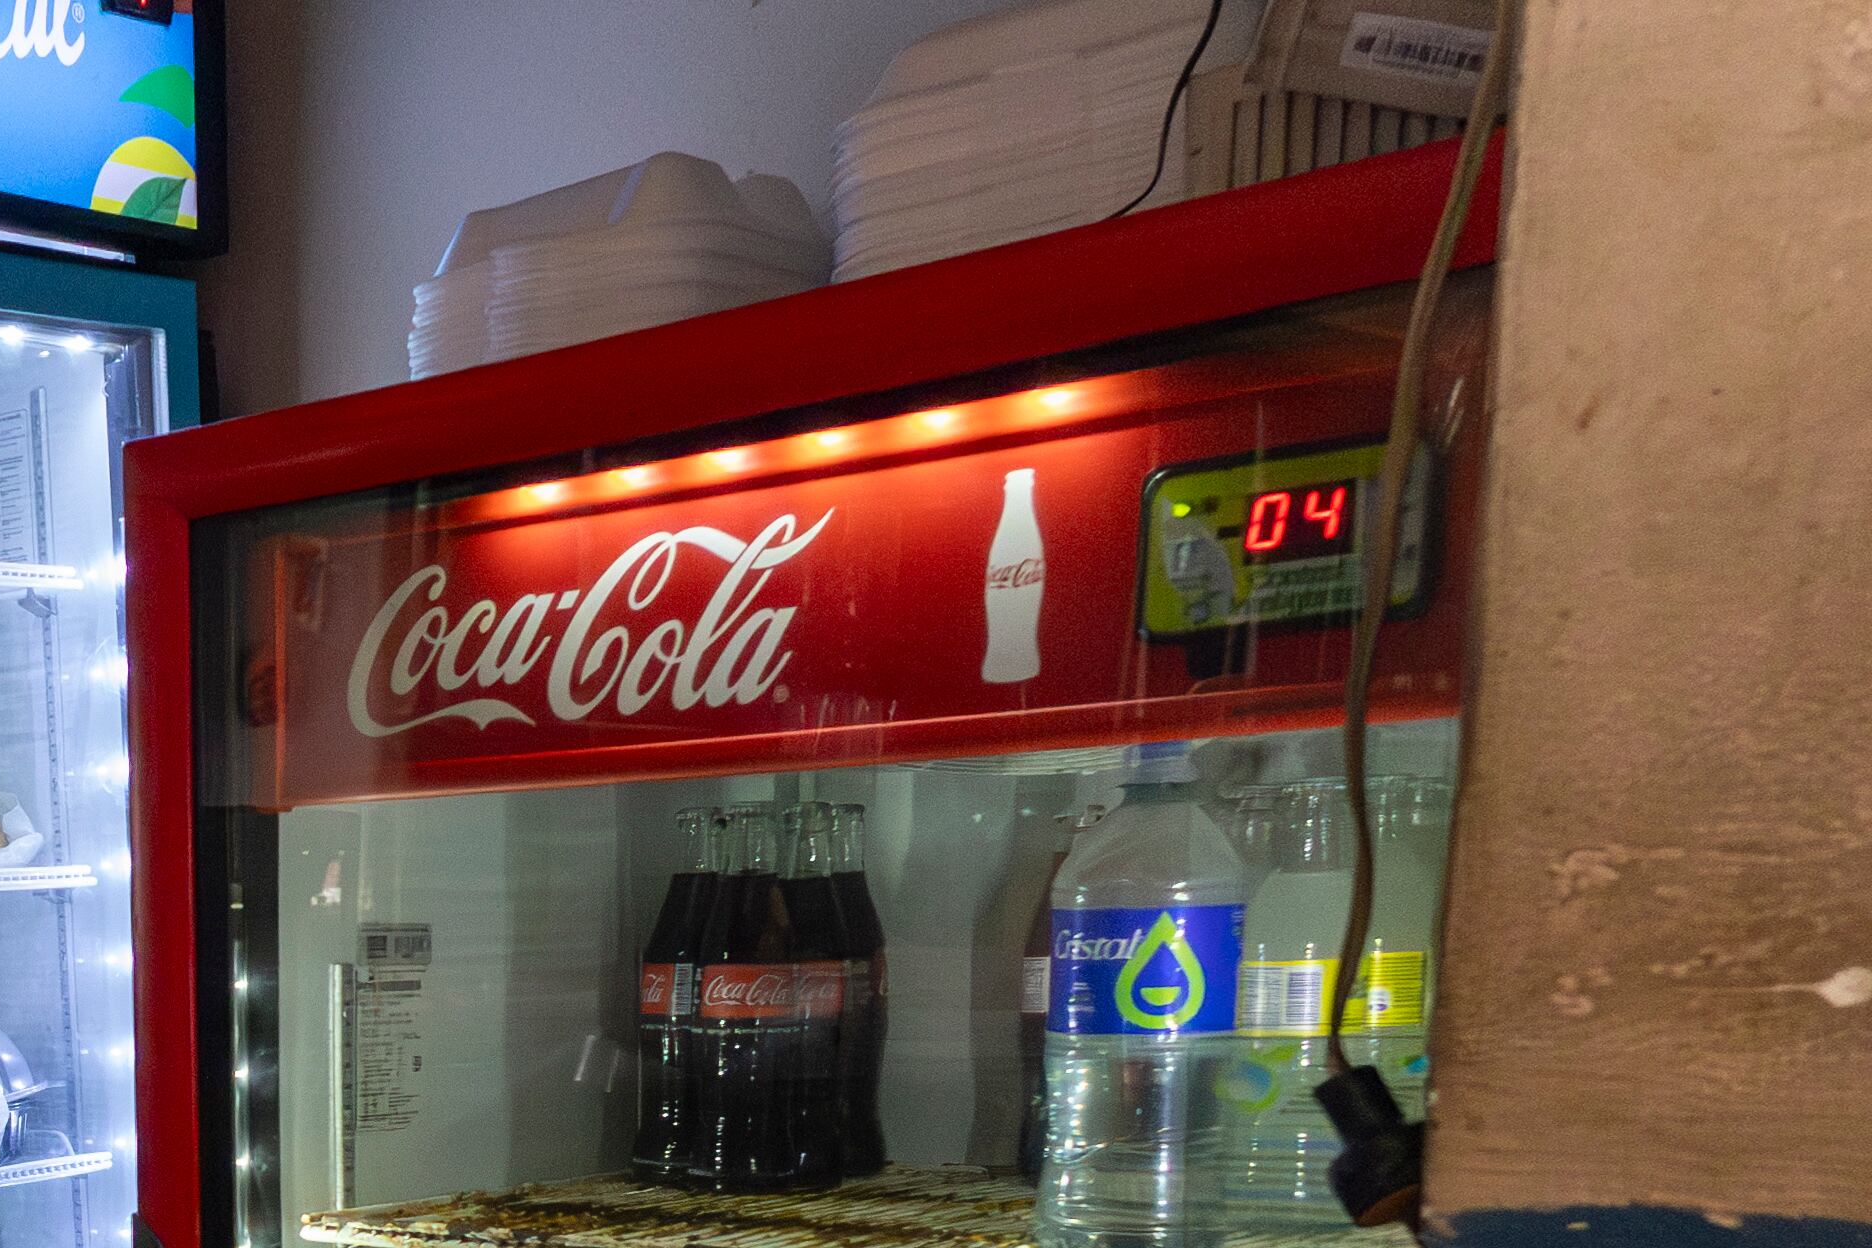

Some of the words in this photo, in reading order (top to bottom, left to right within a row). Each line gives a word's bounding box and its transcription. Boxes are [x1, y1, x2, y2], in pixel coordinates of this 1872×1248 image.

[1245, 486, 1347, 552] 04
[346, 507, 835, 738] Coca-Cola
[1055, 928, 1144, 961] Cristal
[705, 974, 792, 1006] Coca-Cola
